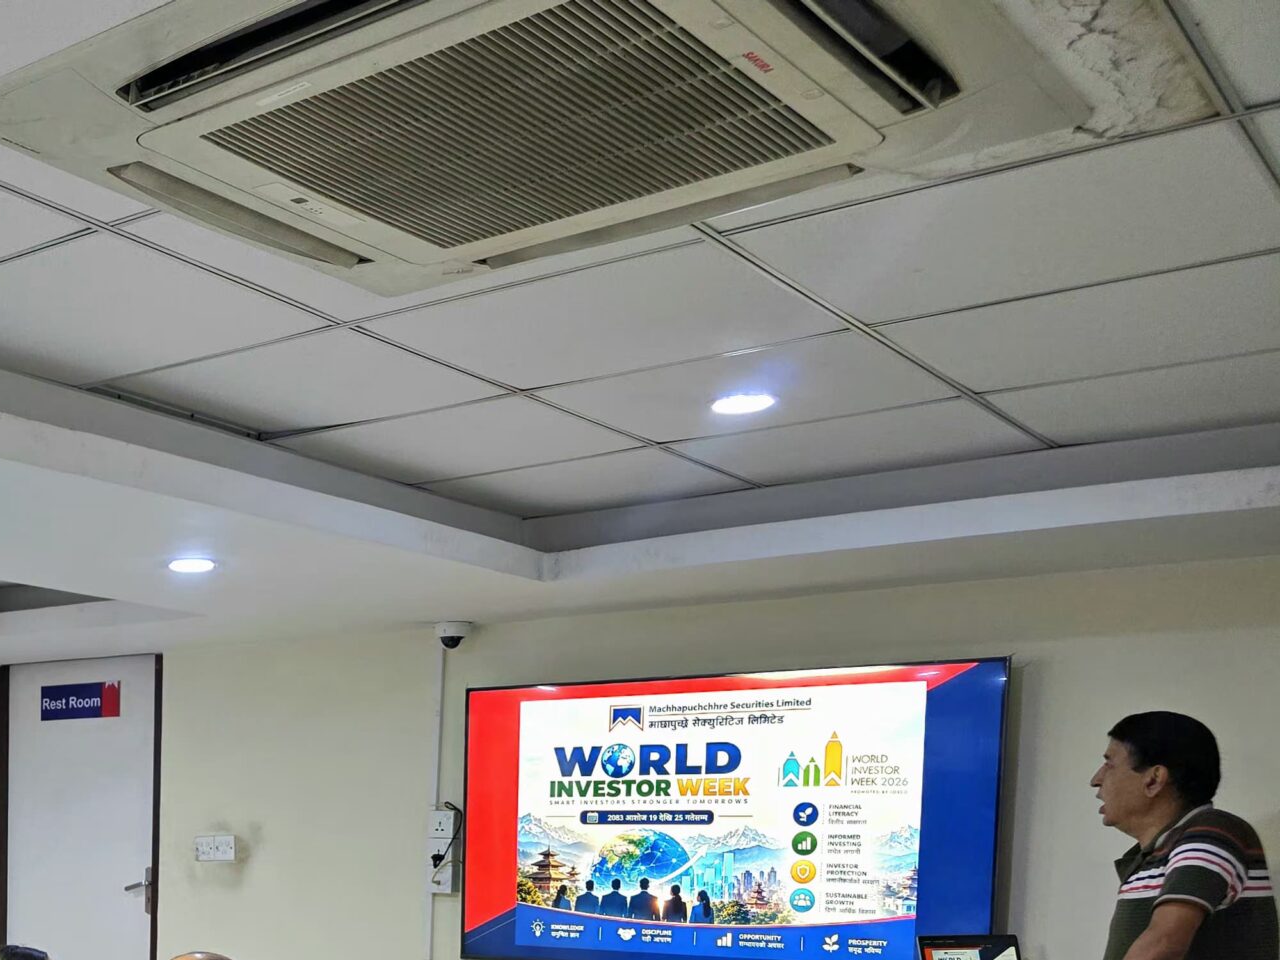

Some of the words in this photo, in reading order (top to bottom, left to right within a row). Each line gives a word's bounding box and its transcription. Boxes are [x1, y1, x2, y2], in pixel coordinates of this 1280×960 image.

[42, 698, 66, 710] Rest
[69, 696, 101, 709] Room
[648, 703, 728, 714] Machhapuchchhre
[730, 701, 774, 710] Securities
[776, 697, 812, 708] Limited
[748, 713, 785, 726] लिमिटेड
[554, 741, 742, 779] WORLD
[851, 754, 888, 764] WORLD
[851, 765, 900, 775] INVESTOR
[851, 777, 877, 786] WEEK
[881, 777, 909, 787] 2026
[549, 779, 671, 798] INVESTOR
[677, 777, 751, 797] WEEK
[825, 892, 868, 900] SUSTAINABLE
[641, 928, 673, 936] DISCIPLINE
[738, 934, 782, 942] OPPORTUNITY
[847, 939, 888, 947] PROSPERITY
